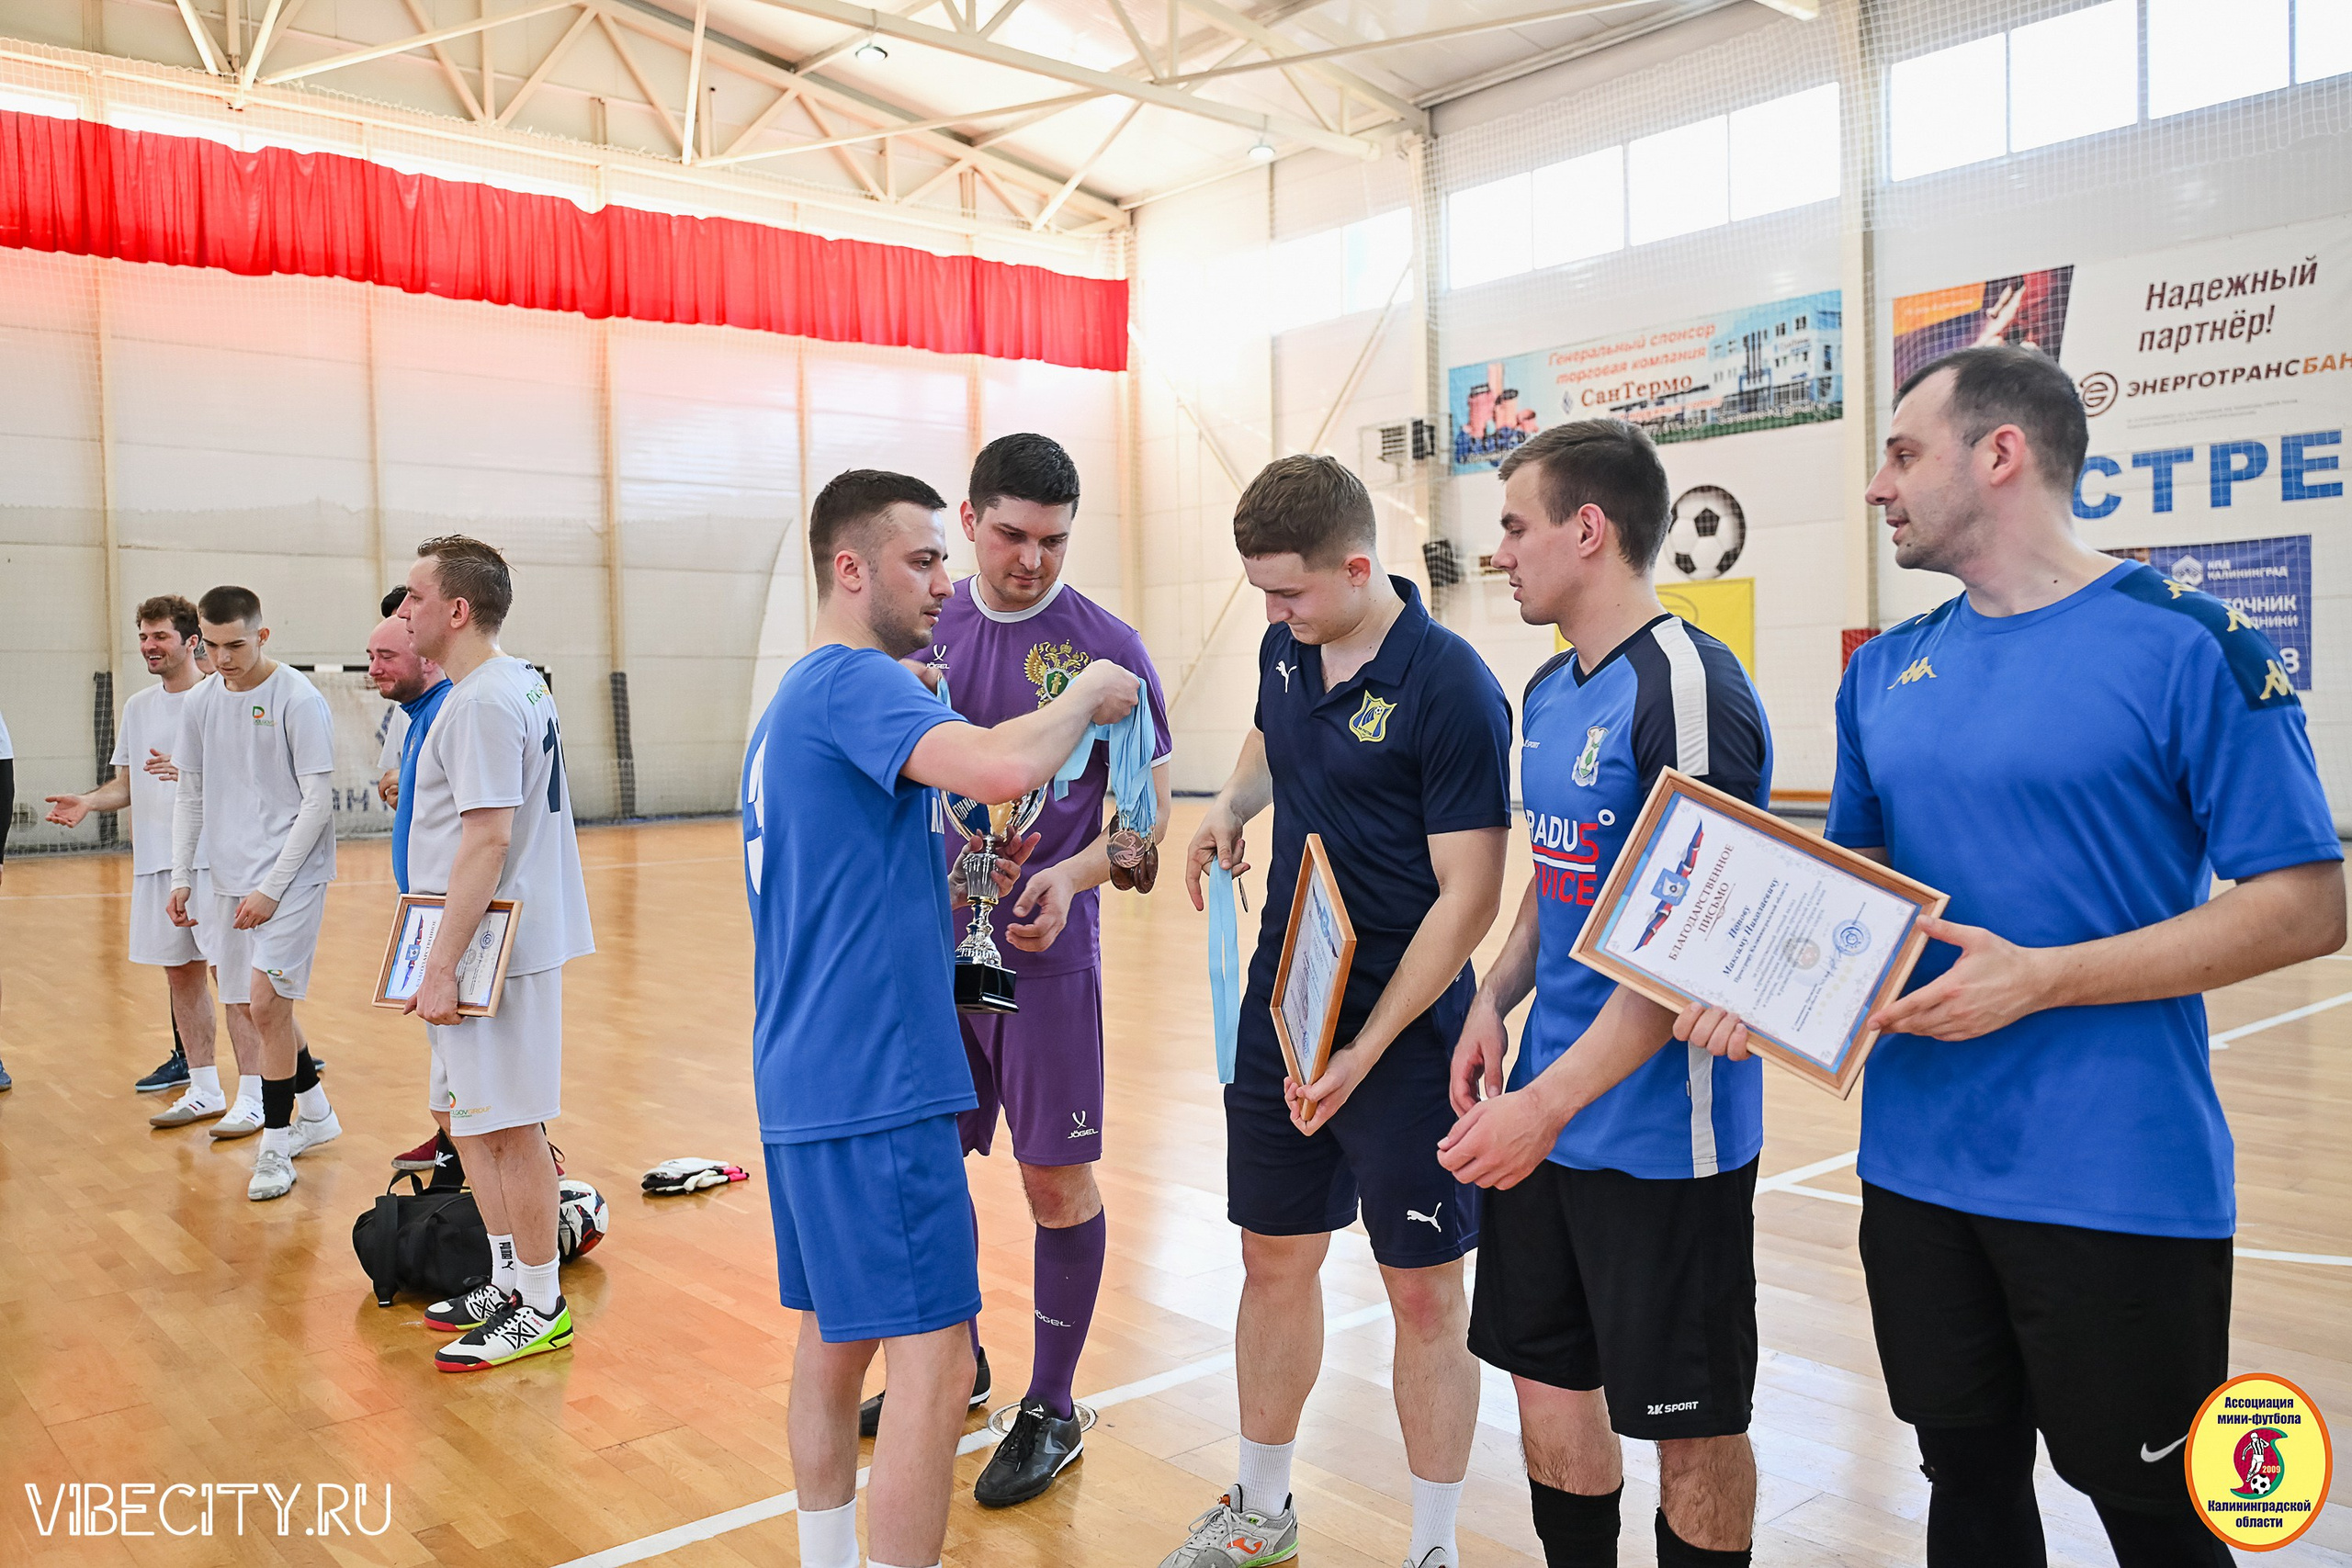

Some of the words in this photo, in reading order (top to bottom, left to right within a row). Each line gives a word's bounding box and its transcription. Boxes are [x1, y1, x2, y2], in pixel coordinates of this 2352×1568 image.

[2145, 254, 2318, 310] Надежный
[1548, 334, 1646, 367] Генеральный
[1650, 323, 1715, 347] спонсор
[2138, 305, 2275, 353] партнёр!
[1556, 361, 1627, 384] торговая
[1632, 345, 1707, 370] компания
[1580, 375, 1692, 406] СанТермо
[2208, 566, 2289, 581] КАЛИНИНГРАД
[1535, 862, 1597, 907] VICE
[1668, 842, 1734, 962] БЛАГОДАРСТВЕННОЕ
[1697, 881, 1730, 933] ПИСЬМО
[1726, 903, 1752, 939] Попову
[1068, 1128, 1099, 1139] JÖGEL
[1665, 1401, 1699, 1413] SPORT
